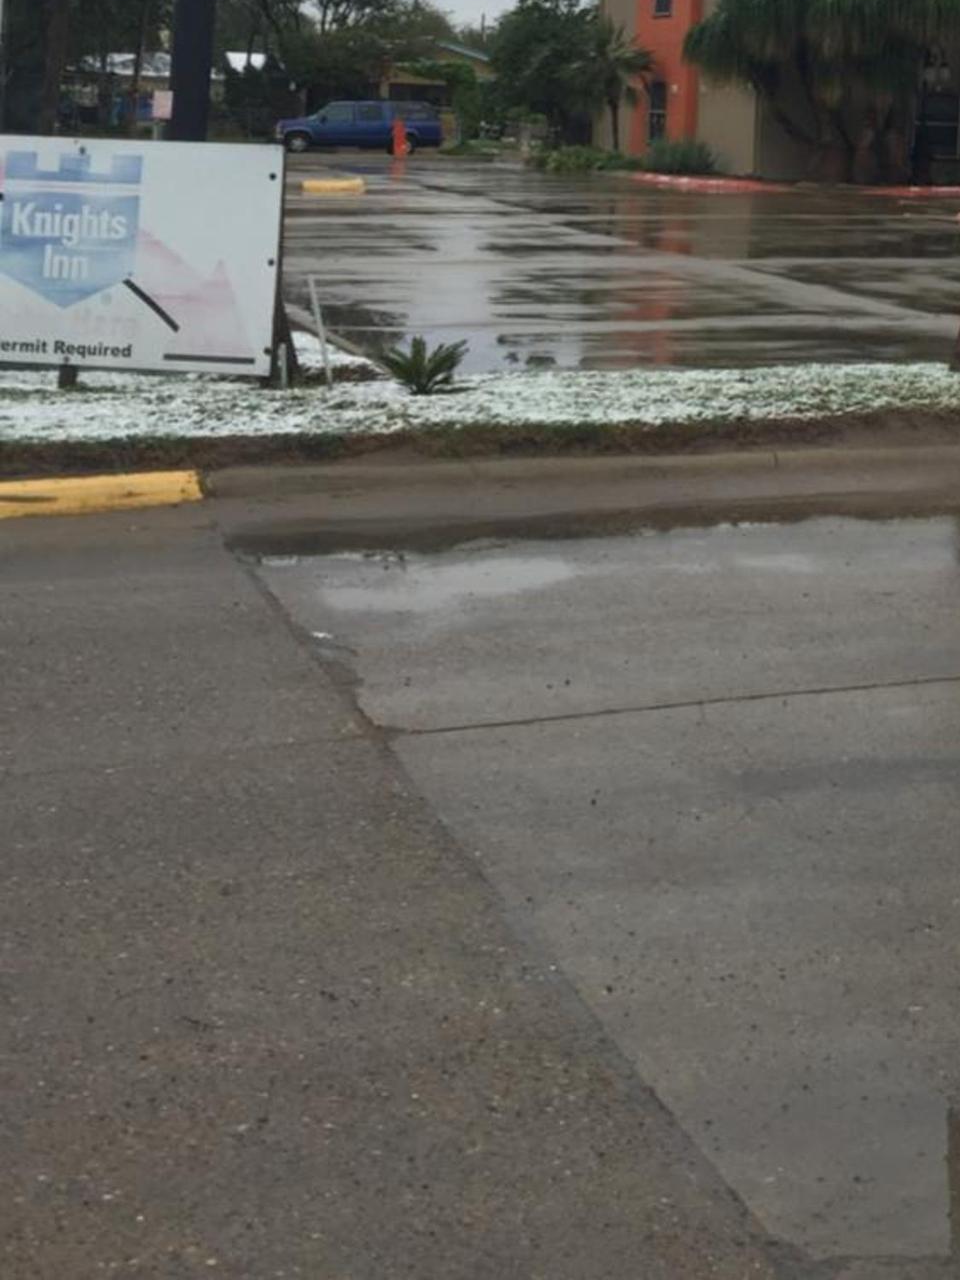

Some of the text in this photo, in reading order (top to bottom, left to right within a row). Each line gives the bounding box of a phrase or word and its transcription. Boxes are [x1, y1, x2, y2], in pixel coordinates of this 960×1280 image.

[11, 201, 128, 246] Knights
[43, 244, 88, 280] Inn
[0, 339, 133, 359] ermit Required
